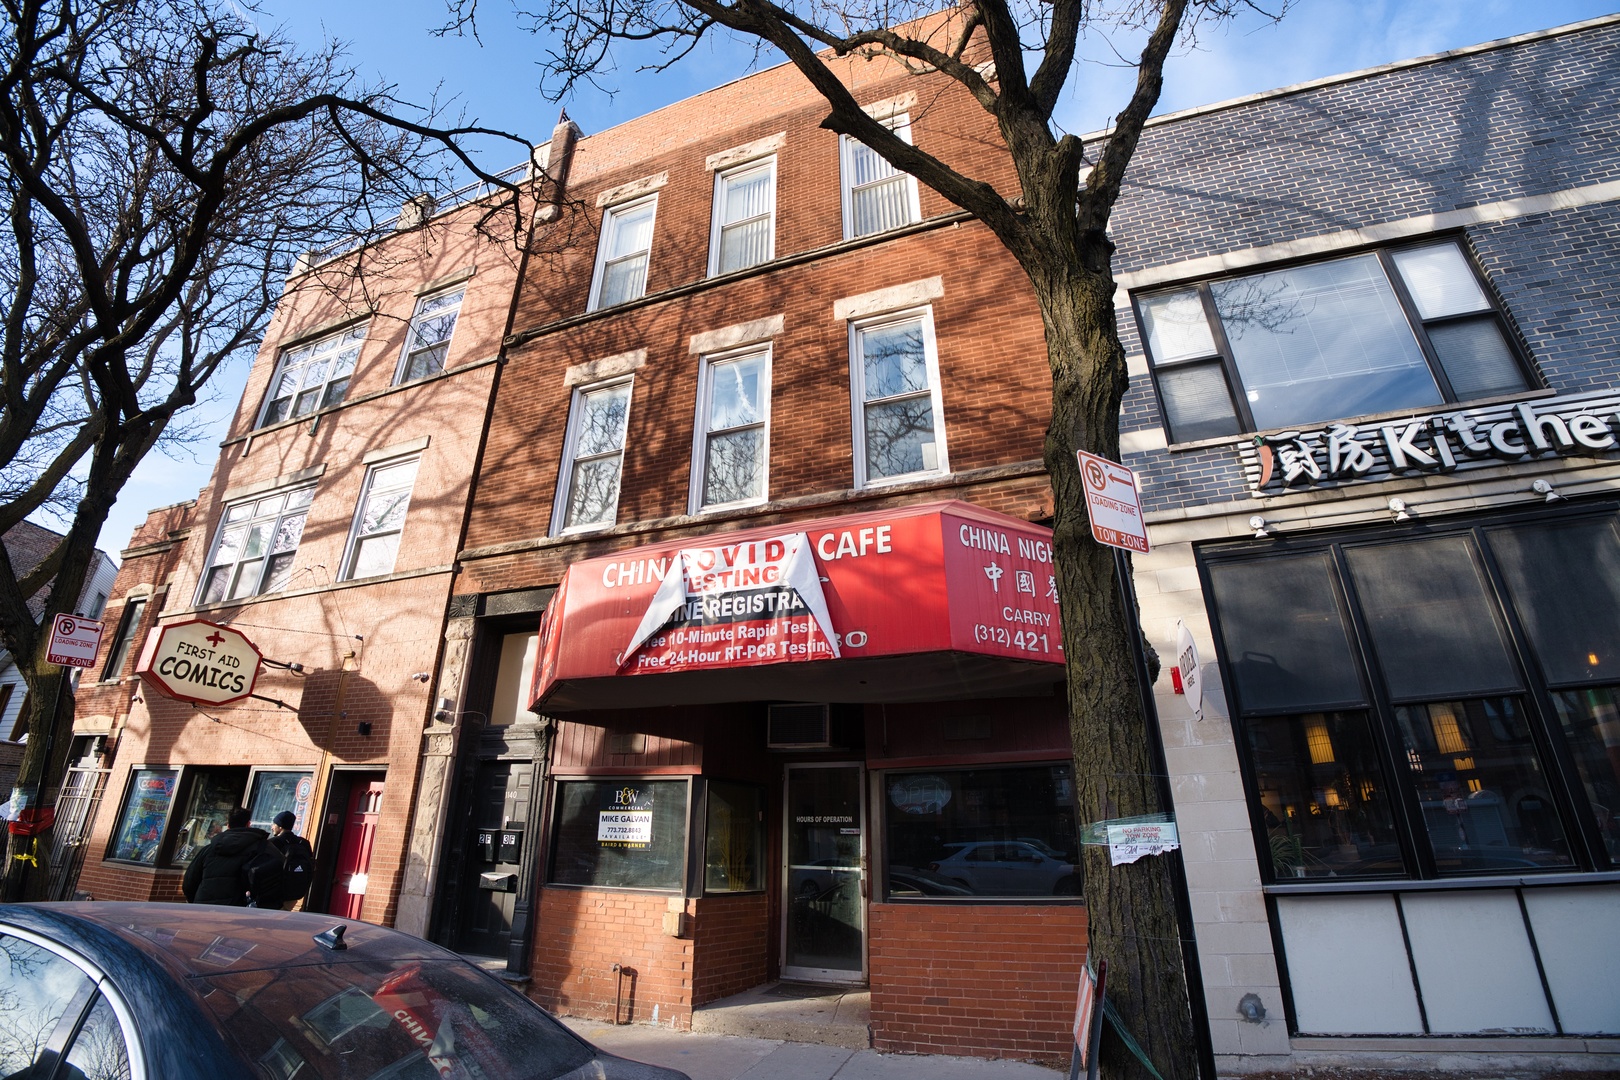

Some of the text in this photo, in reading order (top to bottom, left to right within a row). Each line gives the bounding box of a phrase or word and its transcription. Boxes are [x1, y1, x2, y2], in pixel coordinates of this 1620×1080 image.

[1380, 402, 1620, 473] Kitche
[1091, 495, 1136, 516] LOADING ZONE
[959, 523, 1011, 556] CHINA
[1097, 526, 1146, 551] TOW ZONE
[602, 525, 892, 588] CHIN CAFE
[668, 602, 704, 622] INE
[1002, 606, 1051, 627] CARRY
[55, 637, 79, 647] LOADING
[644, 620, 821, 649] ree 10-Minute Rapid Testi
[974, 623, 1049, 653] (312) 421
[51, 654, 93, 667] TOW ZONE
[176, 641, 241, 669] FIRST AID
[637, 654, 667, 668] Free
[669, 648, 722, 665] 24-Hour
[725, 642, 777, 661] RT-PCR
[159, 656, 246, 693] COMICS
[505, 791, 517, 799] 1140
[896, 782, 947, 804] OPEN
[601, 815, 650, 823] MIKE GALVAN
